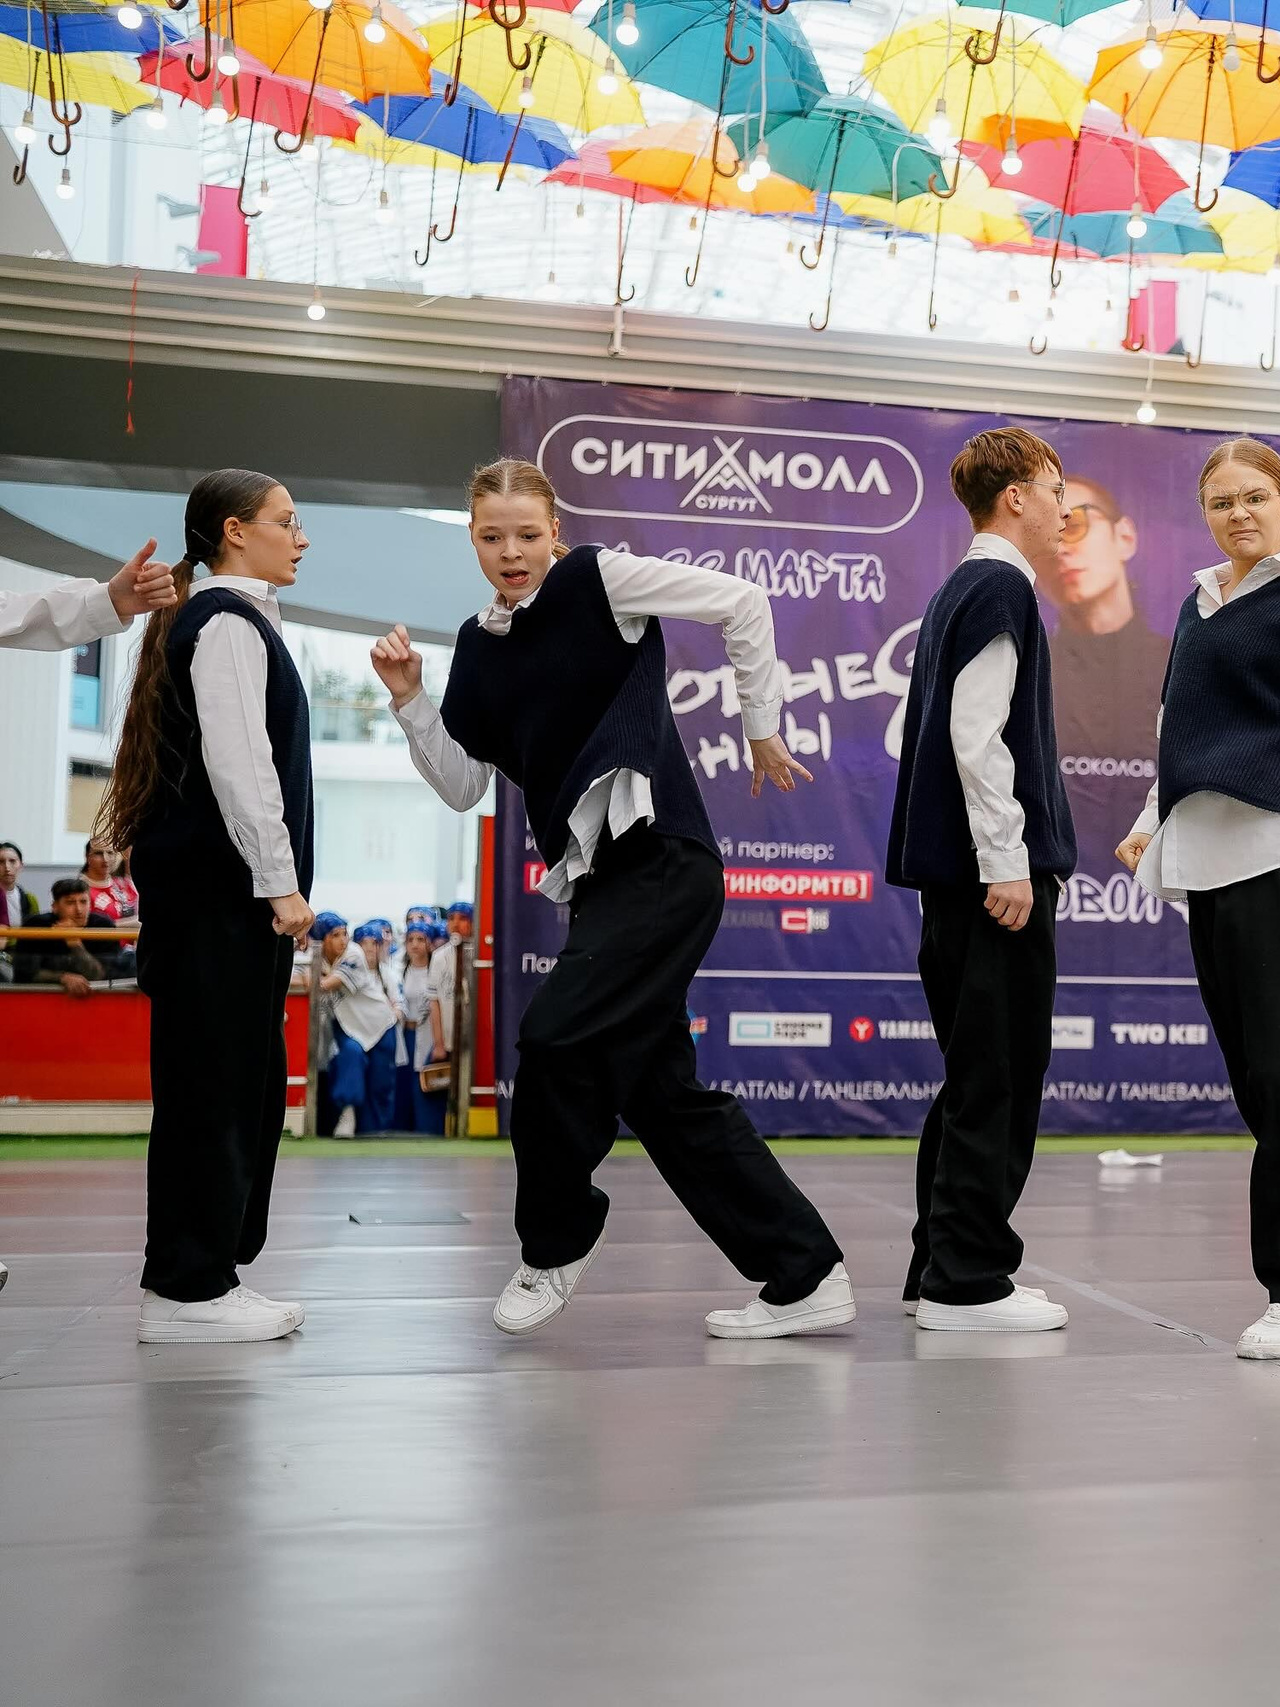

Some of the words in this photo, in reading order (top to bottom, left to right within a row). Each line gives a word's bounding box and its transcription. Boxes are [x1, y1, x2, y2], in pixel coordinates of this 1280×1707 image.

[571, 437, 708, 481] СИТИ
[748, 448, 893, 496] МОЛЛ
[695, 495, 759, 512] СУРГУТ
[735, 547, 886, 603] МАРТА
[1060, 755, 1157, 778] СОКОЛОВ
[738, 841, 835, 863] партнер:
[724, 872, 868, 899] ИНФОРМТВ]
[1110, 1022, 1167, 1045] TWO
[1168, 1024, 1208, 1045] KEI
[812, 1080, 944, 1101] ТАНЦЕВАЛЬН
[1045, 1081, 1104, 1101] АТТЛЫ
